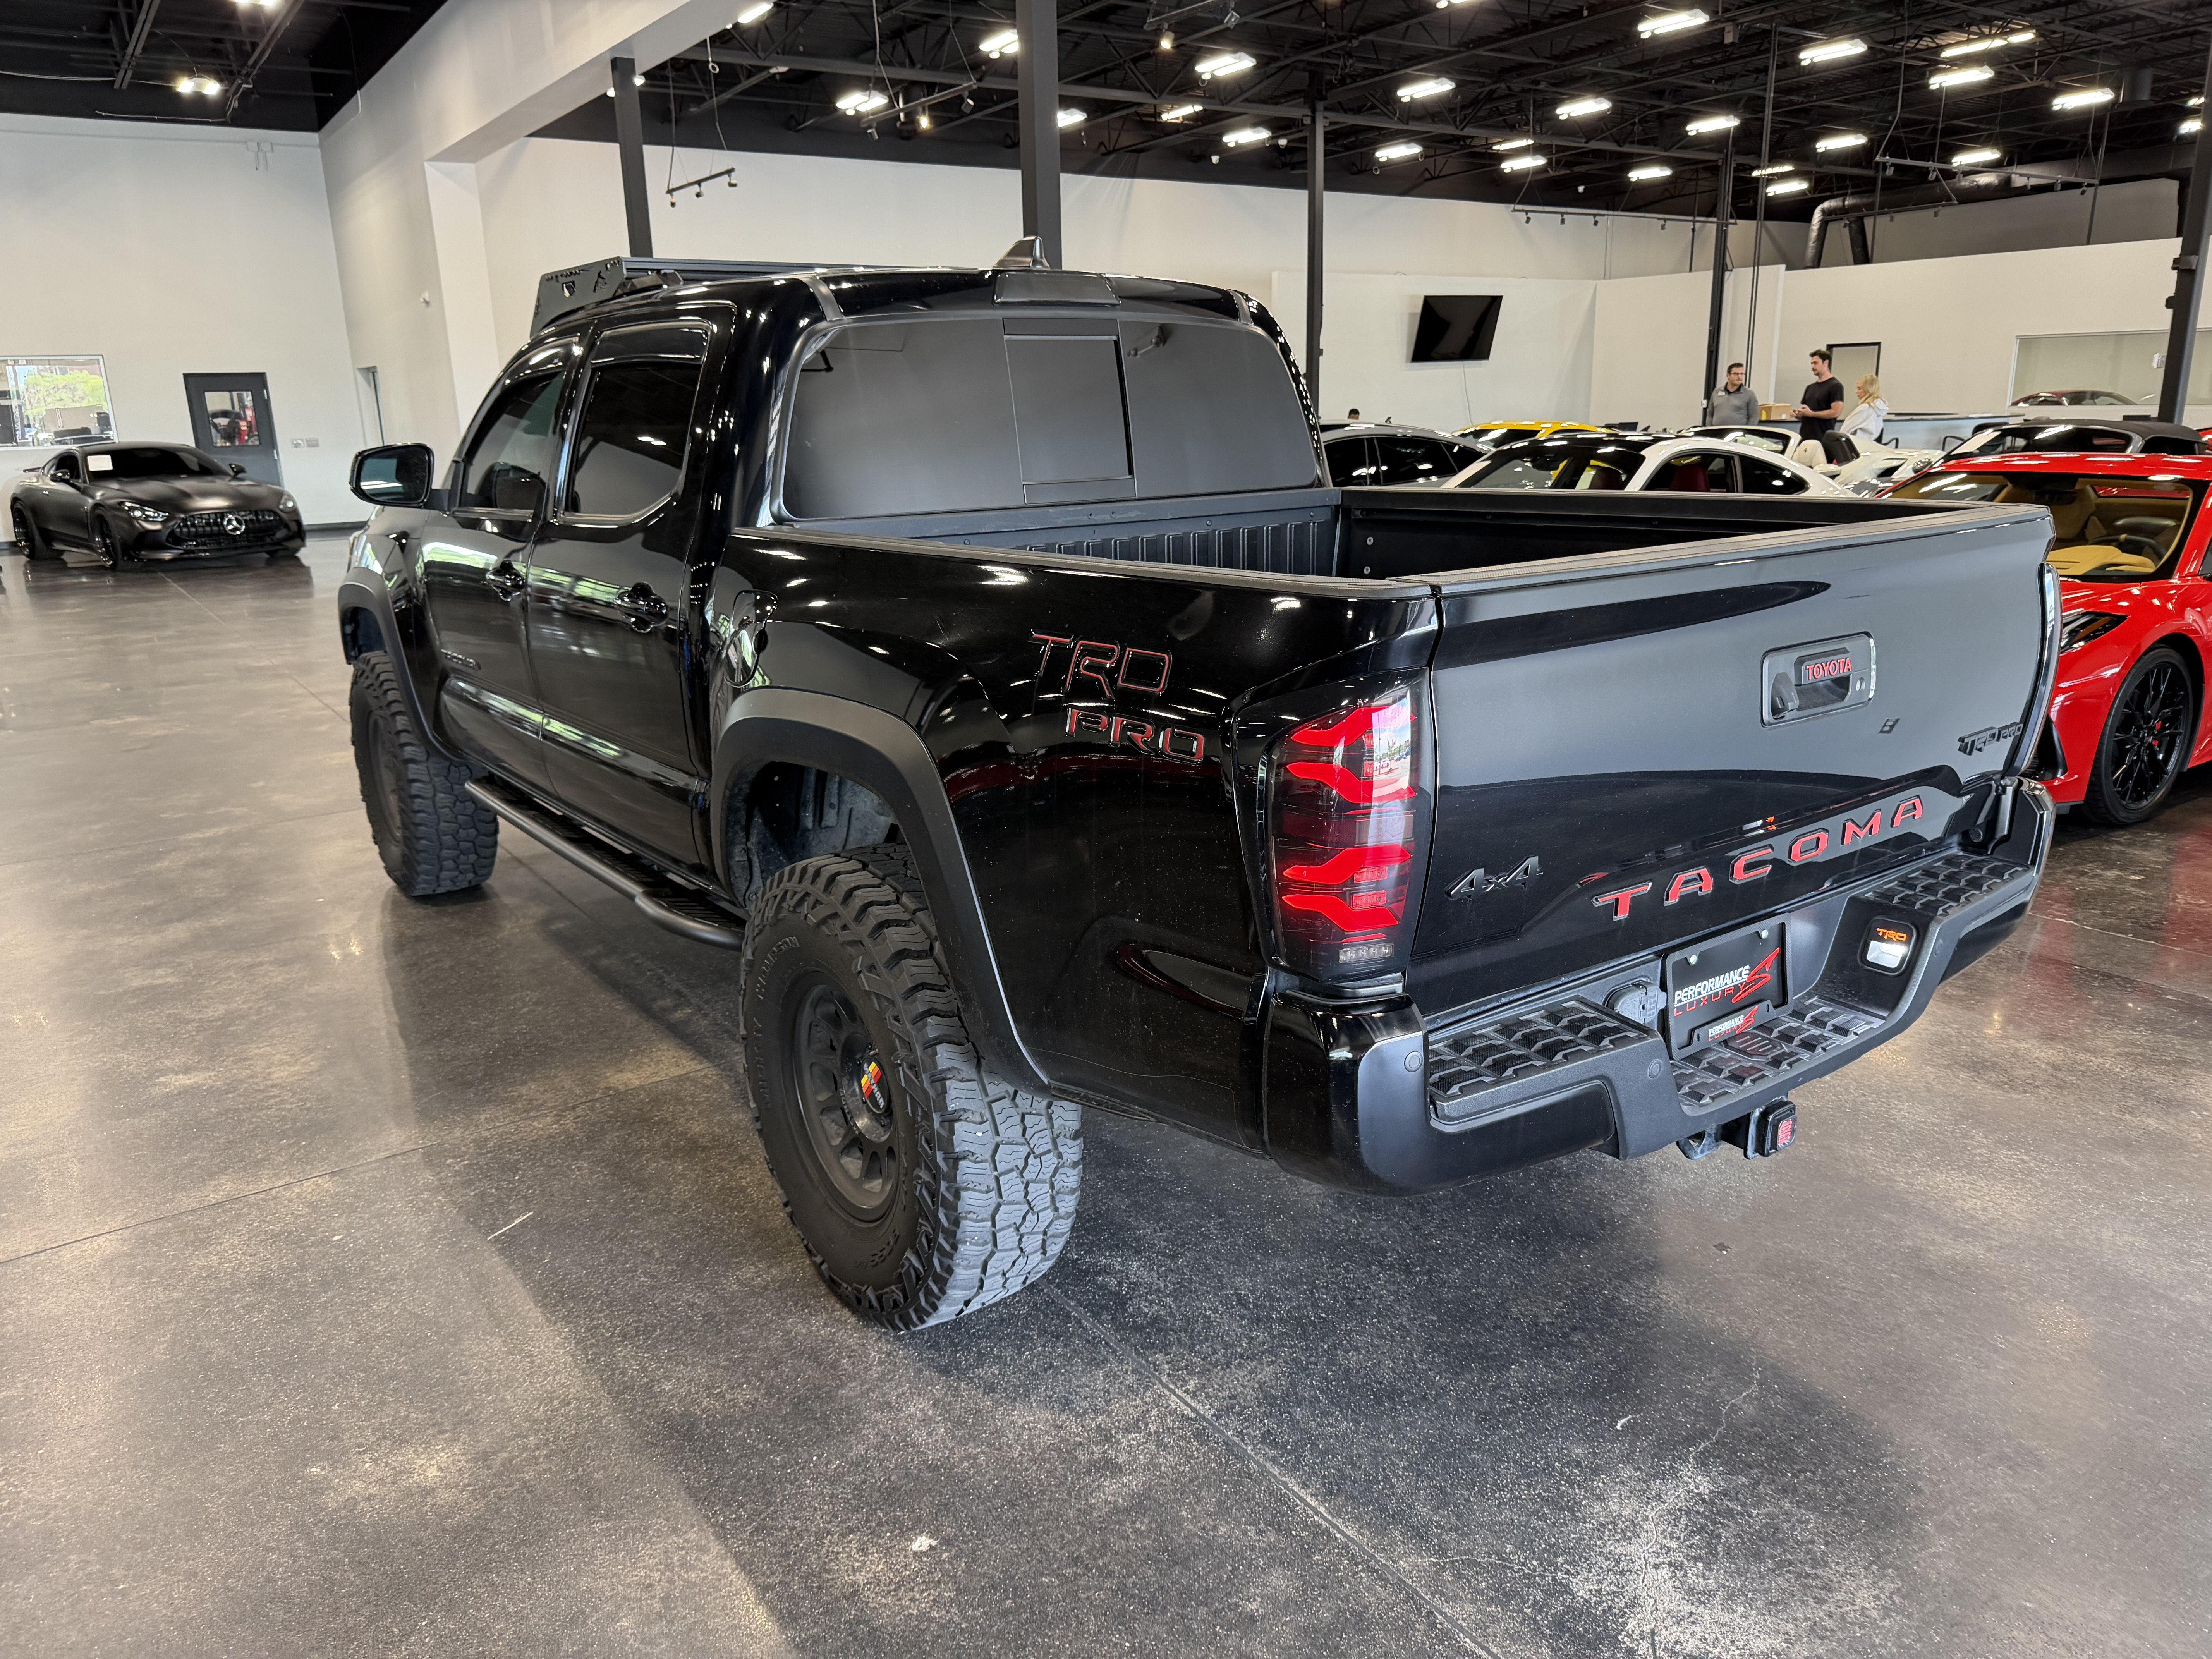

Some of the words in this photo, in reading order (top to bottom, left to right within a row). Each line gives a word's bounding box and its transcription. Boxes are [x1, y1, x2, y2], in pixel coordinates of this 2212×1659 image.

[1029, 629, 1172, 700] TRD
[1805, 657, 1853, 680] TOYOTA
[1065, 707, 1204, 762] PRO
[1958, 727, 1999, 756] TRD
[1997, 723, 2024, 742] PRO
[1445, 855, 1544, 900] 4x4
[1592, 795, 1923, 921] TACOMA
[1876, 928, 1907, 941] TRD
[1674, 965, 1750, 1005] PERFORMANCE
[1674, 982, 1746, 1017] LUXURY
